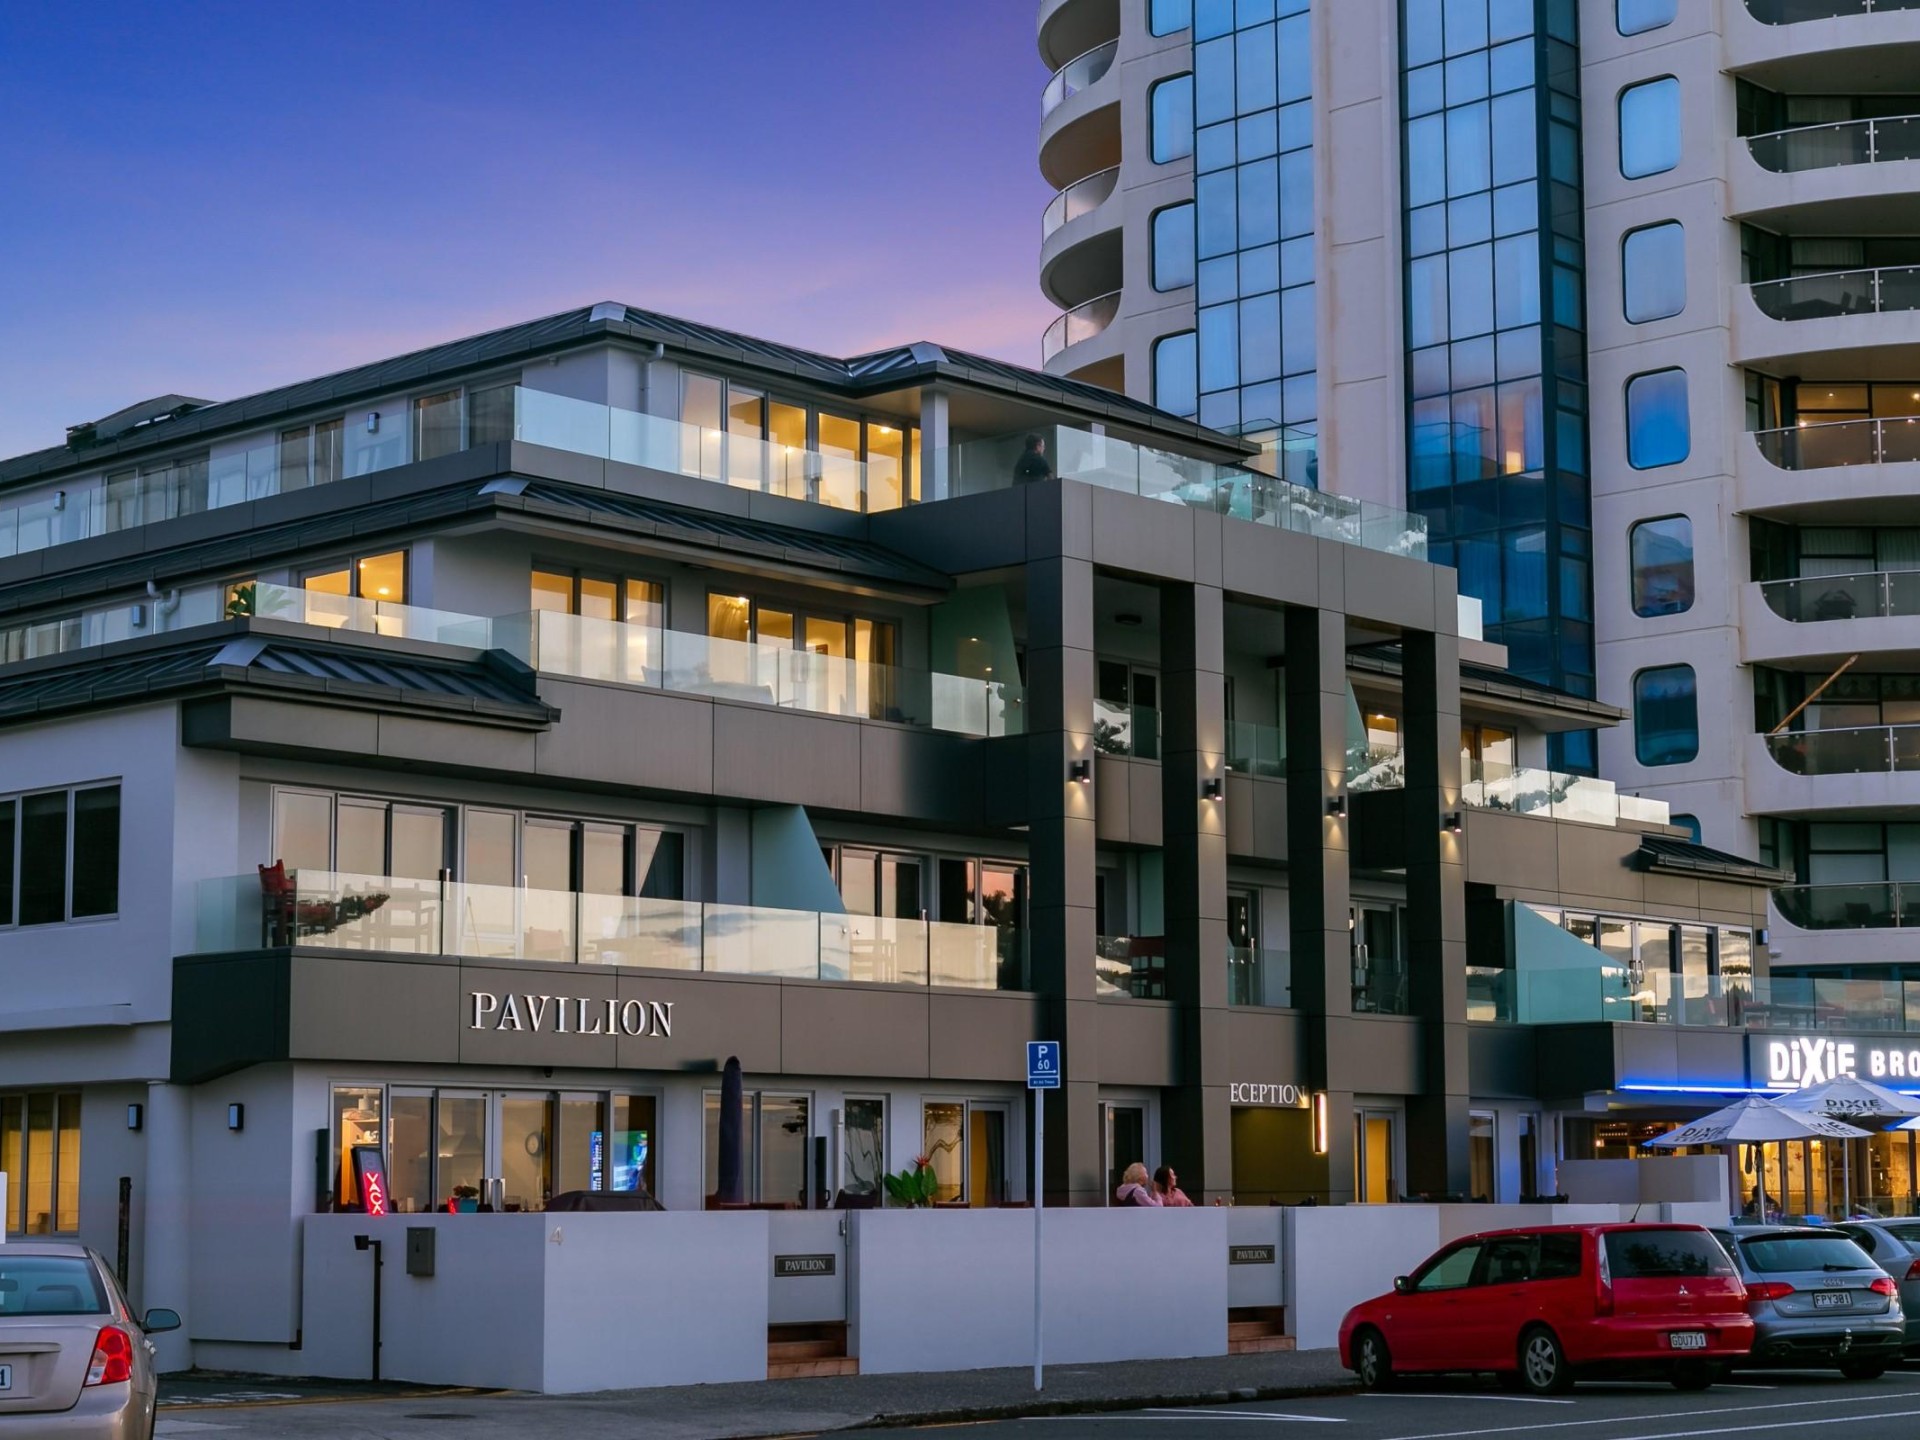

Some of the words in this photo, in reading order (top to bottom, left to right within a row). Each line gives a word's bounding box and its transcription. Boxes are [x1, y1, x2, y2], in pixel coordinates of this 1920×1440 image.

[470, 992, 675, 1037] PAVILION
[1038, 1045, 1048, 1059] P
[1037, 1059, 1050, 1070] 60
[1870, 1050, 1920, 1077] BRO
[1236, 1250, 1268, 1260] PAVILION
[784, 1259, 826, 1271] PAVILION
